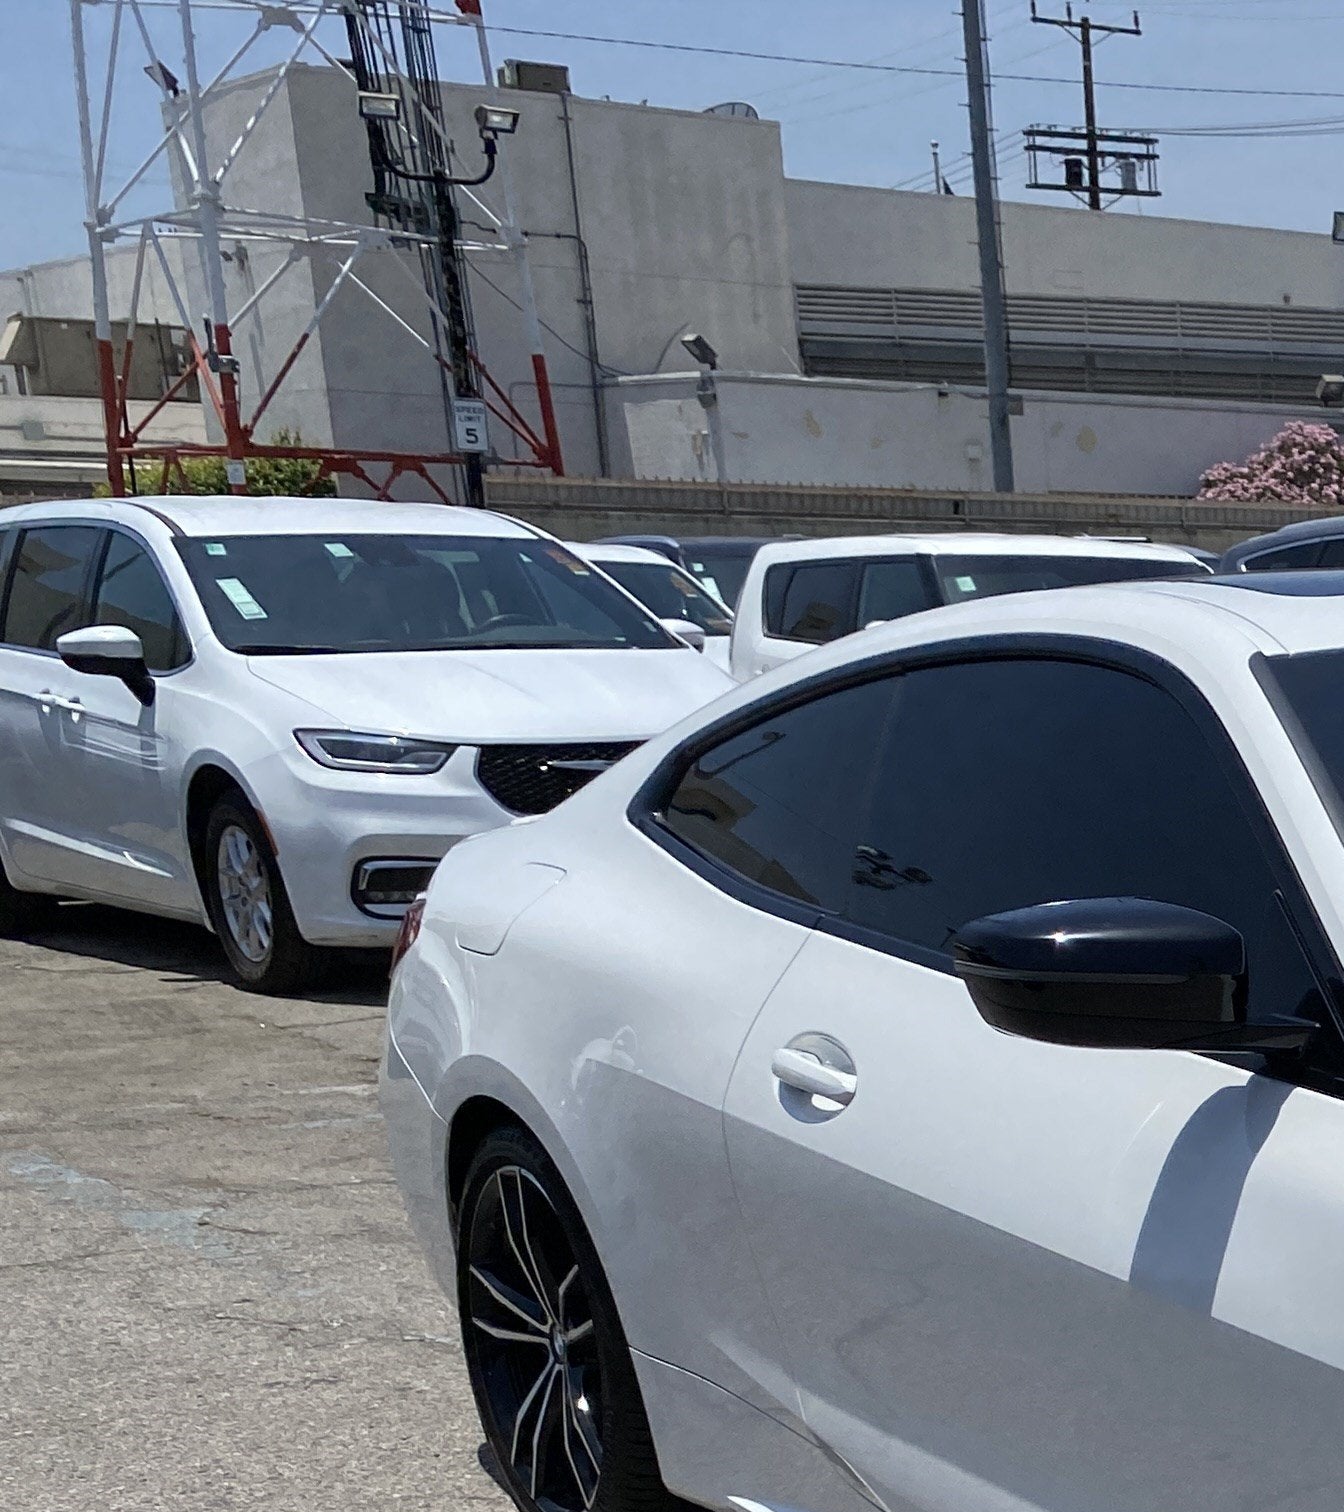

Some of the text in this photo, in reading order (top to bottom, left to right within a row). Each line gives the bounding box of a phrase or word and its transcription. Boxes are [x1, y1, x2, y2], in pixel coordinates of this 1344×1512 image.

[455, 405, 484, 414] SPEED
[458, 414, 481, 423] LIMIT
[465, 428, 479, 444] 5
